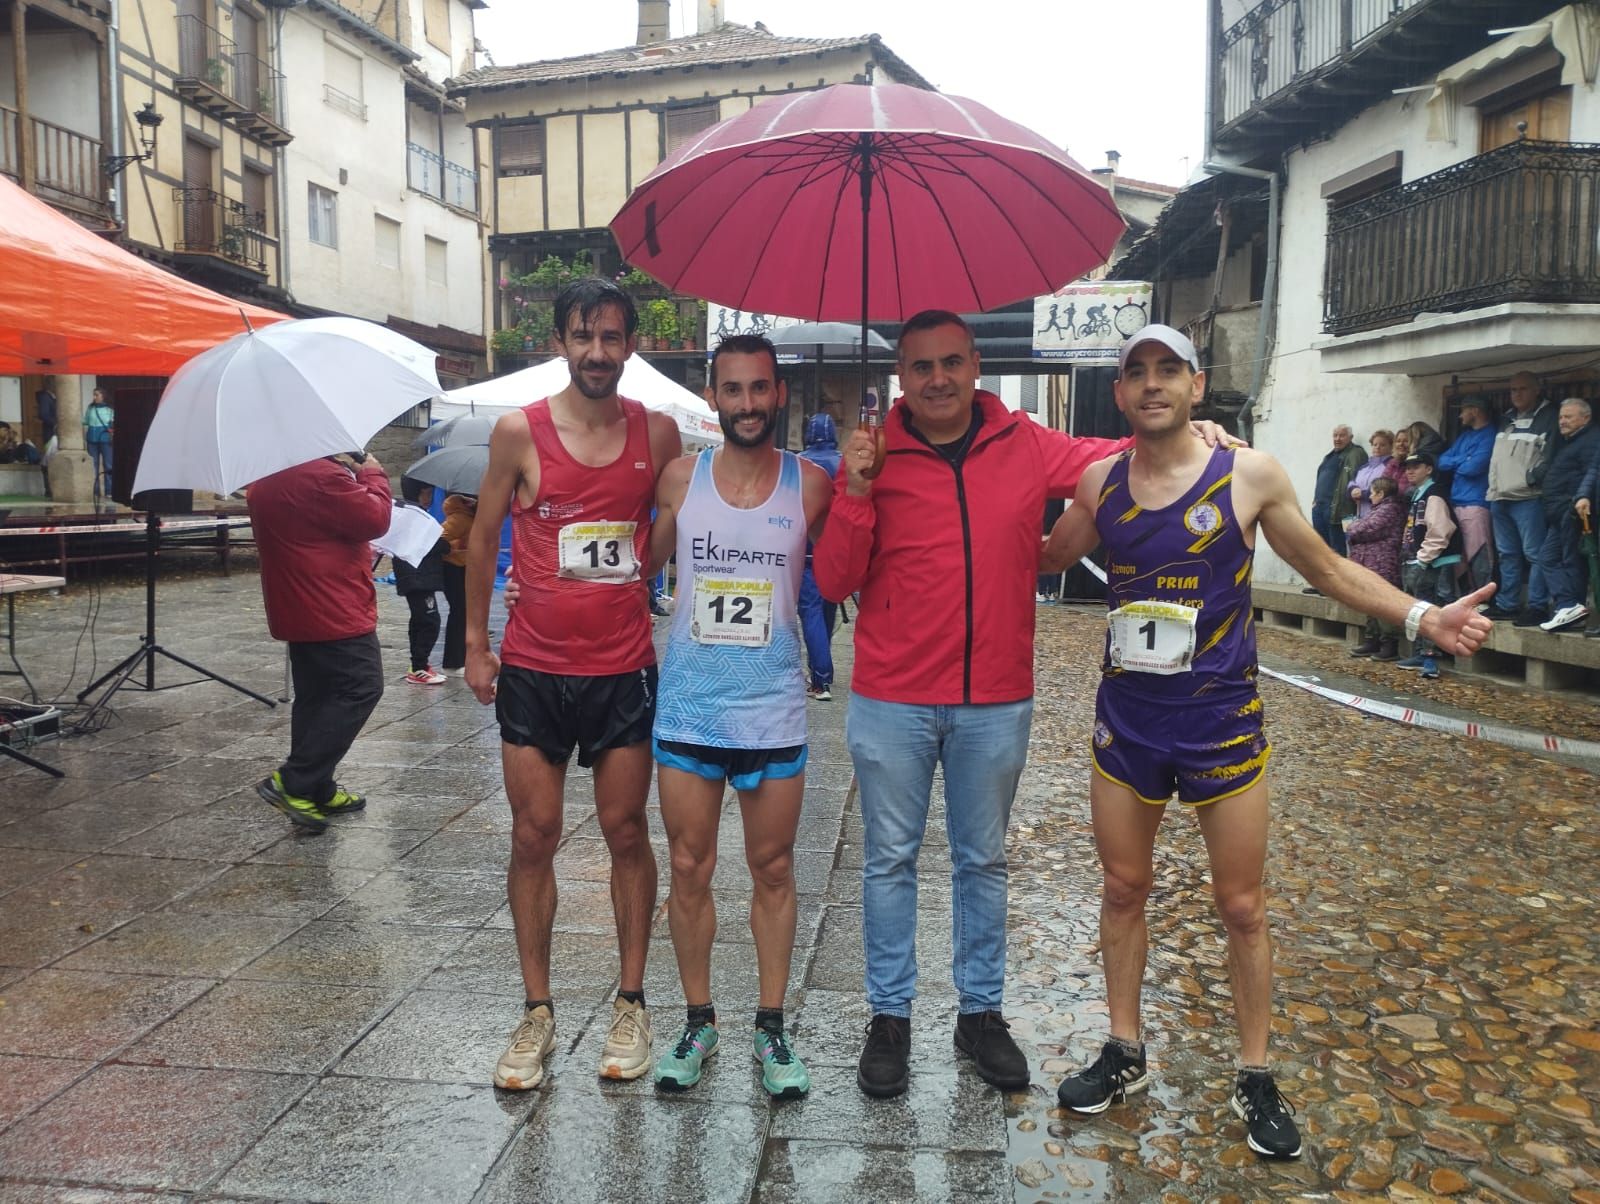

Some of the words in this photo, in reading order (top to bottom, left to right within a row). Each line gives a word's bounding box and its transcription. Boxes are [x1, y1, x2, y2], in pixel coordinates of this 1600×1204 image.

[582, 540, 620, 568] 13
[693, 563, 737, 574] Sportwear
[1156, 576, 1199, 589] PRIM
[708, 595, 753, 624] 12
[1139, 620, 1156, 651] 1
